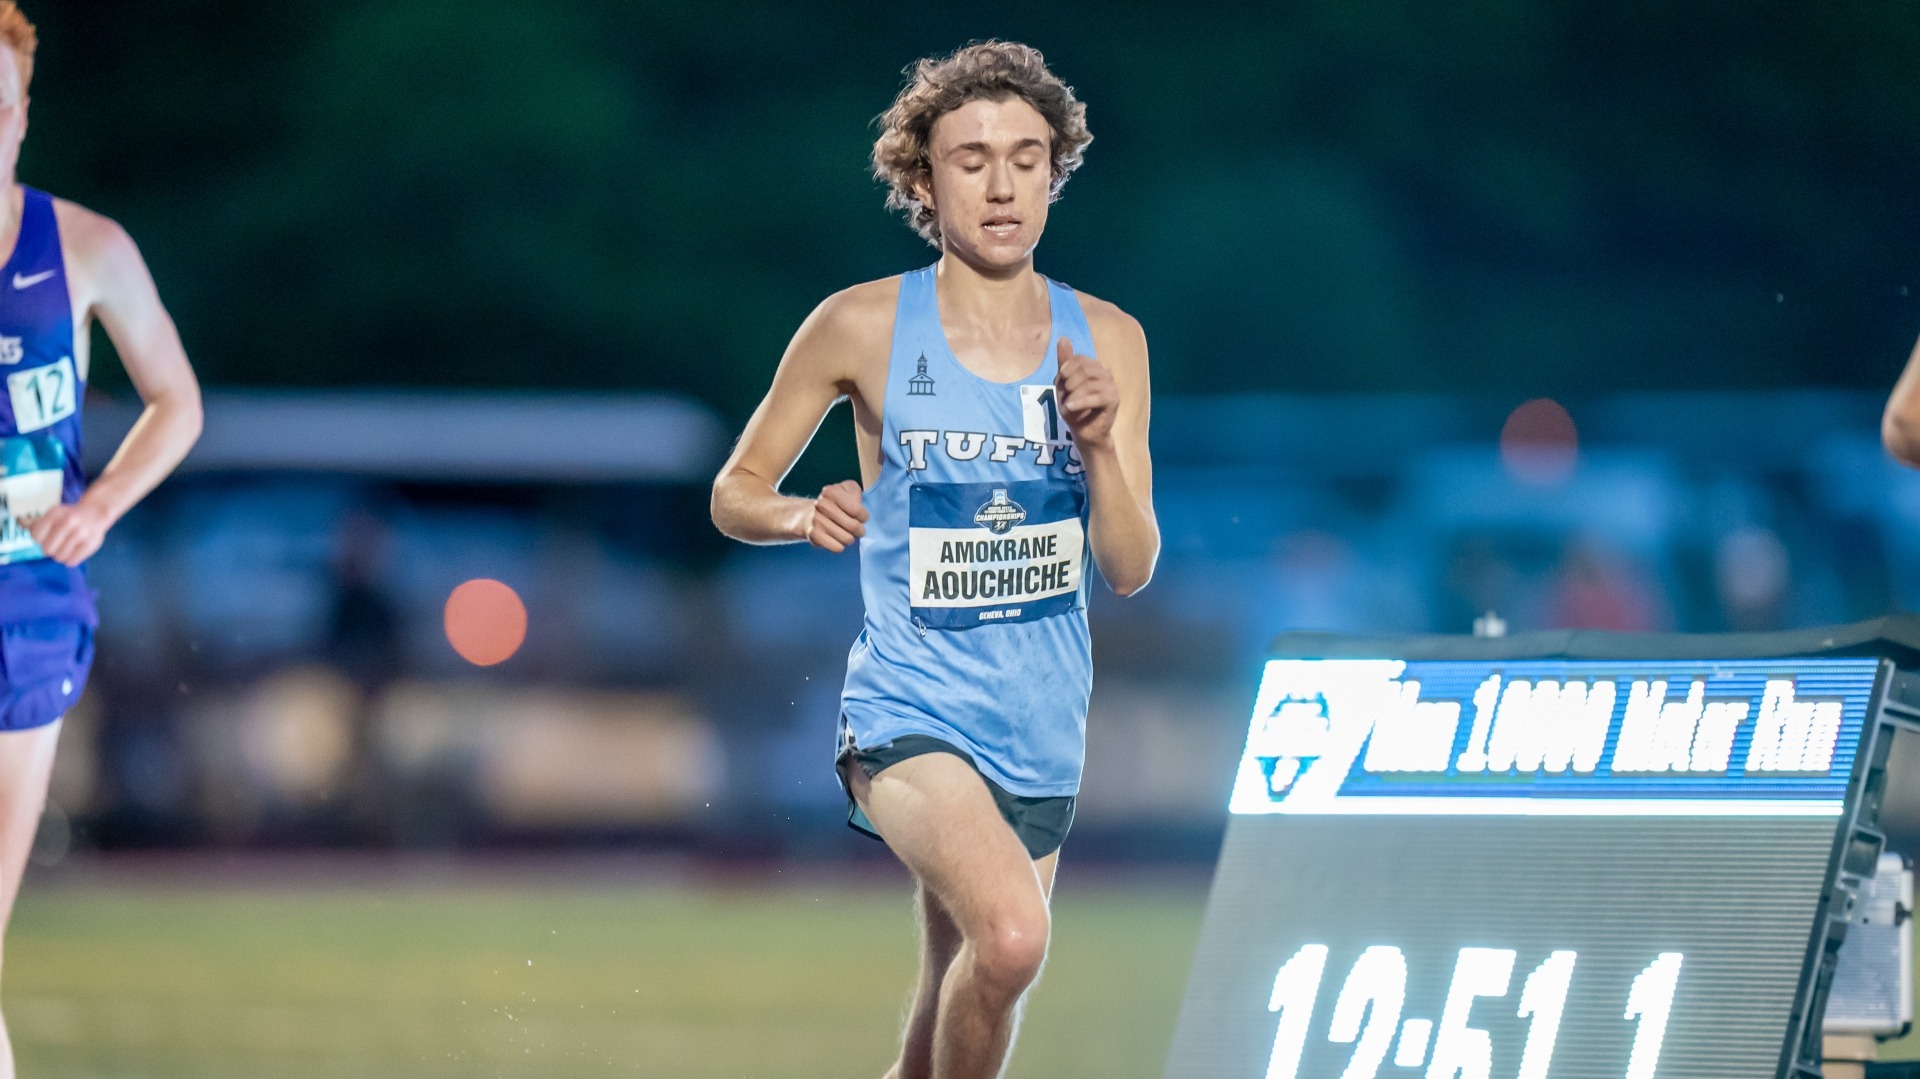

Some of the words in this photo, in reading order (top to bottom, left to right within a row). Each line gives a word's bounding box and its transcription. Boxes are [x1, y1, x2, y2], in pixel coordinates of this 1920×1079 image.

[26, 369, 66, 419] 12
[1037, 388, 1072, 441] 1
[940, 534, 1057, 563] AMOKRANE
[923, 560, 1071, 600] AOUCHICHE
[979, 610, 1004, 620] GENEVA,
[1005, 609, 1021, 617] OHIO
